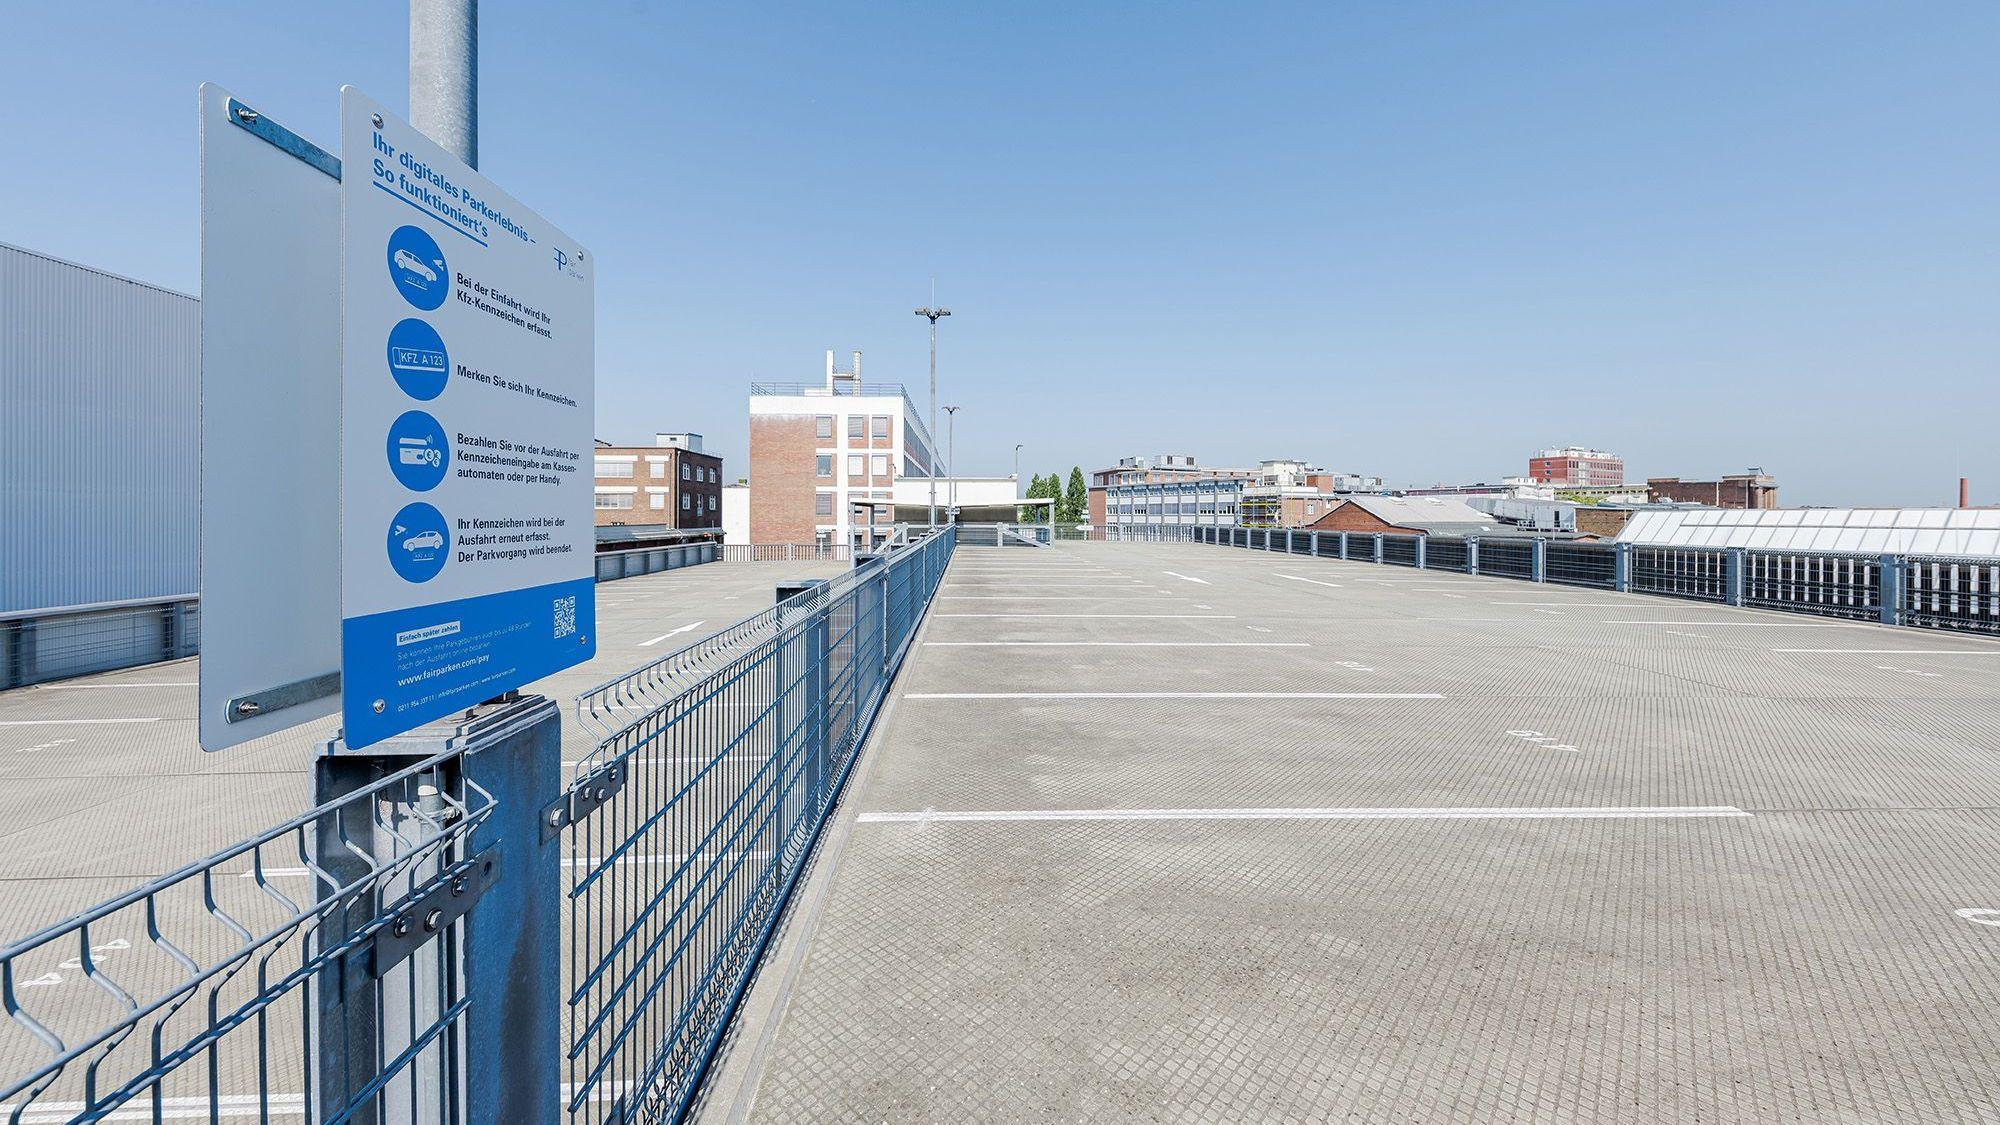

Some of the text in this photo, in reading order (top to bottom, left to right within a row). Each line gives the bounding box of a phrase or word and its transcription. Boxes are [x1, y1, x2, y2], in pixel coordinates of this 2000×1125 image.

[373, 158, 395, 184] So
[372, 131, 395, 158] Ihr
[399, 151, 459, 199] digitales
[462, 189, 529, 242] Parkerlebnis
[457, 272, 552, 325] Bei der Einfahrt wird Ihr
[456, 289, 553, 340] Kfz-Kennzeichen erfasst.
[401, 352, 443, 367] KFZ A 123
[457, 364, 578, 408] Merken Sie sich Ihr Kennzeichen.
[457, 432, 580, 463] Bezahlen Sie vor der Ausfahrt per
[457, 450, 577, 473] Kennzeicheneingabe am Kassen-
[457, 468, 562, 487] automaten oder per Handy.
[457, 517, 565, 530] Ihr Kennzeichen wird bei der
[457, 531, 551, 546] Ausfahrt erneut erfasst.
[457, 543, 572, 563] Der Parkvorgang wird beendet.
[399, 625, 459, 643] Einfach später zahlen
[398, 654, 490, 687] www.fairparken.com/pay
